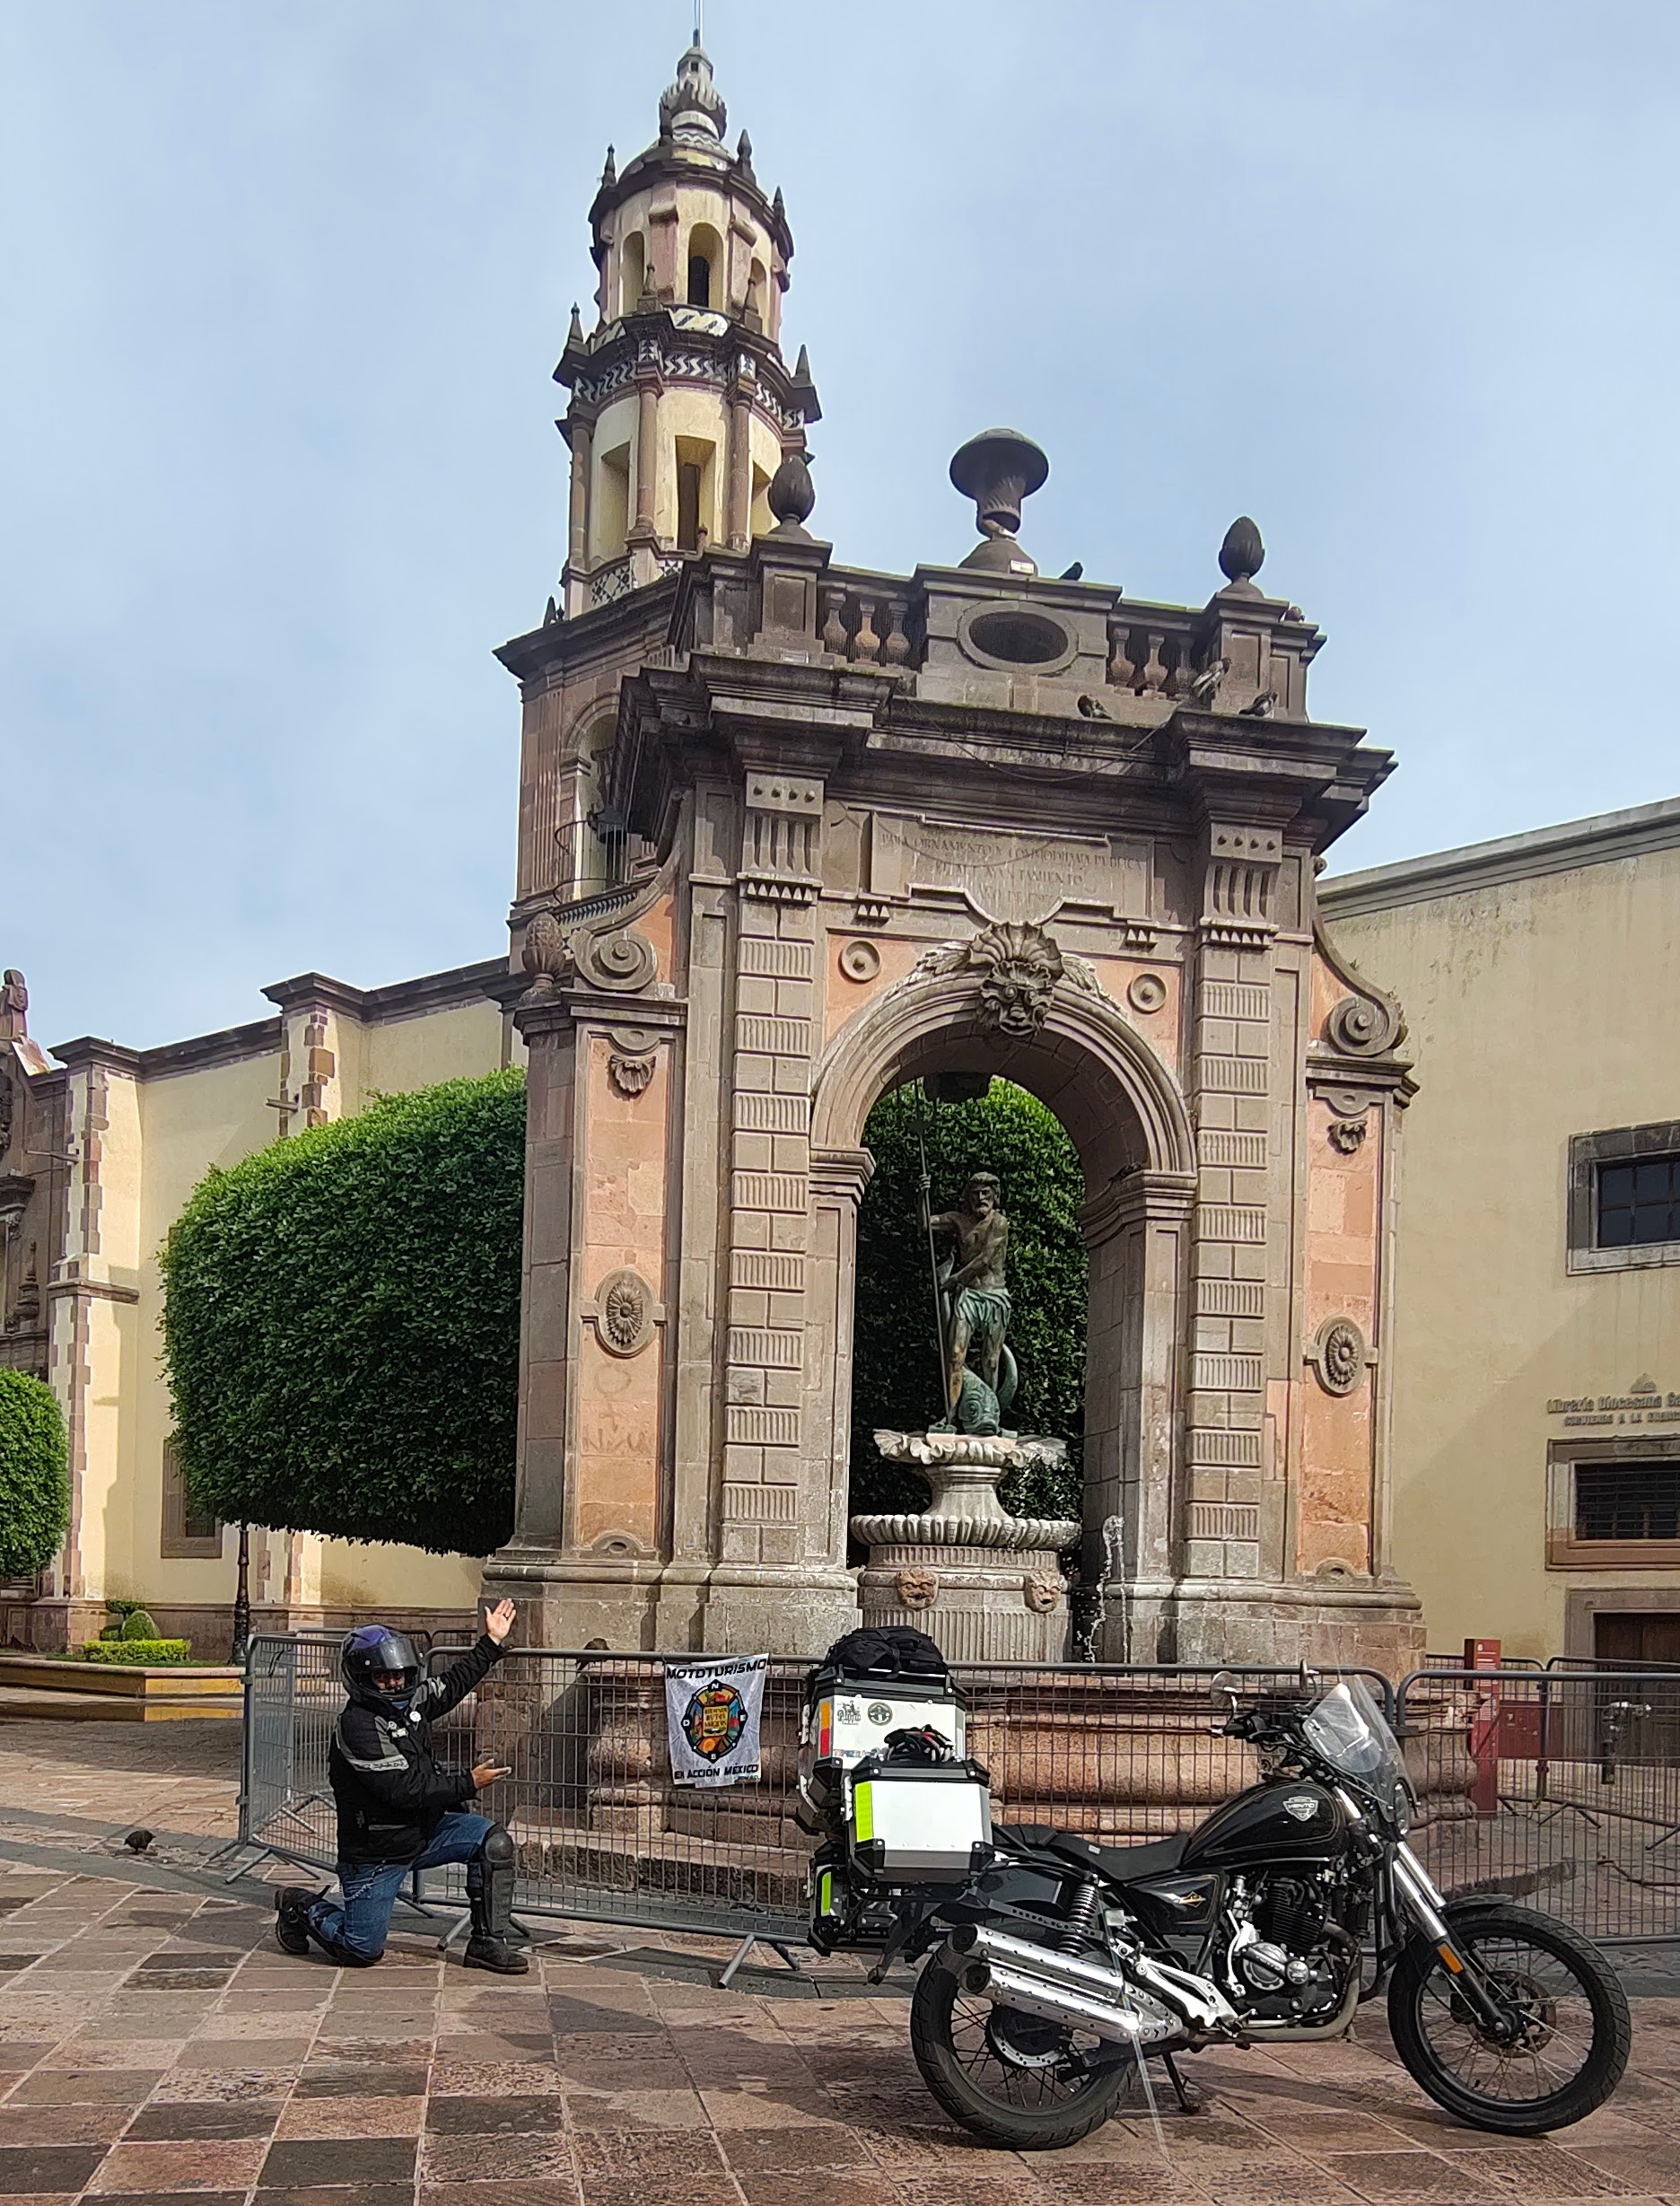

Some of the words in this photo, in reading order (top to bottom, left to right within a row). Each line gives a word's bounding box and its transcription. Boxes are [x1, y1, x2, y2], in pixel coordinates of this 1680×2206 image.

[881, 833, 908, 848] PARA
[914, 837, 991, 855] ORNAMENTO
[1597, 1396, 1662, 1410] Diocesana
[666, 1659, 767, 1679] MOTOTURISMO
[687, 1765, 721, 1779] ACCIÓN
[724, 1762, 760, 1776] MÉXICO
